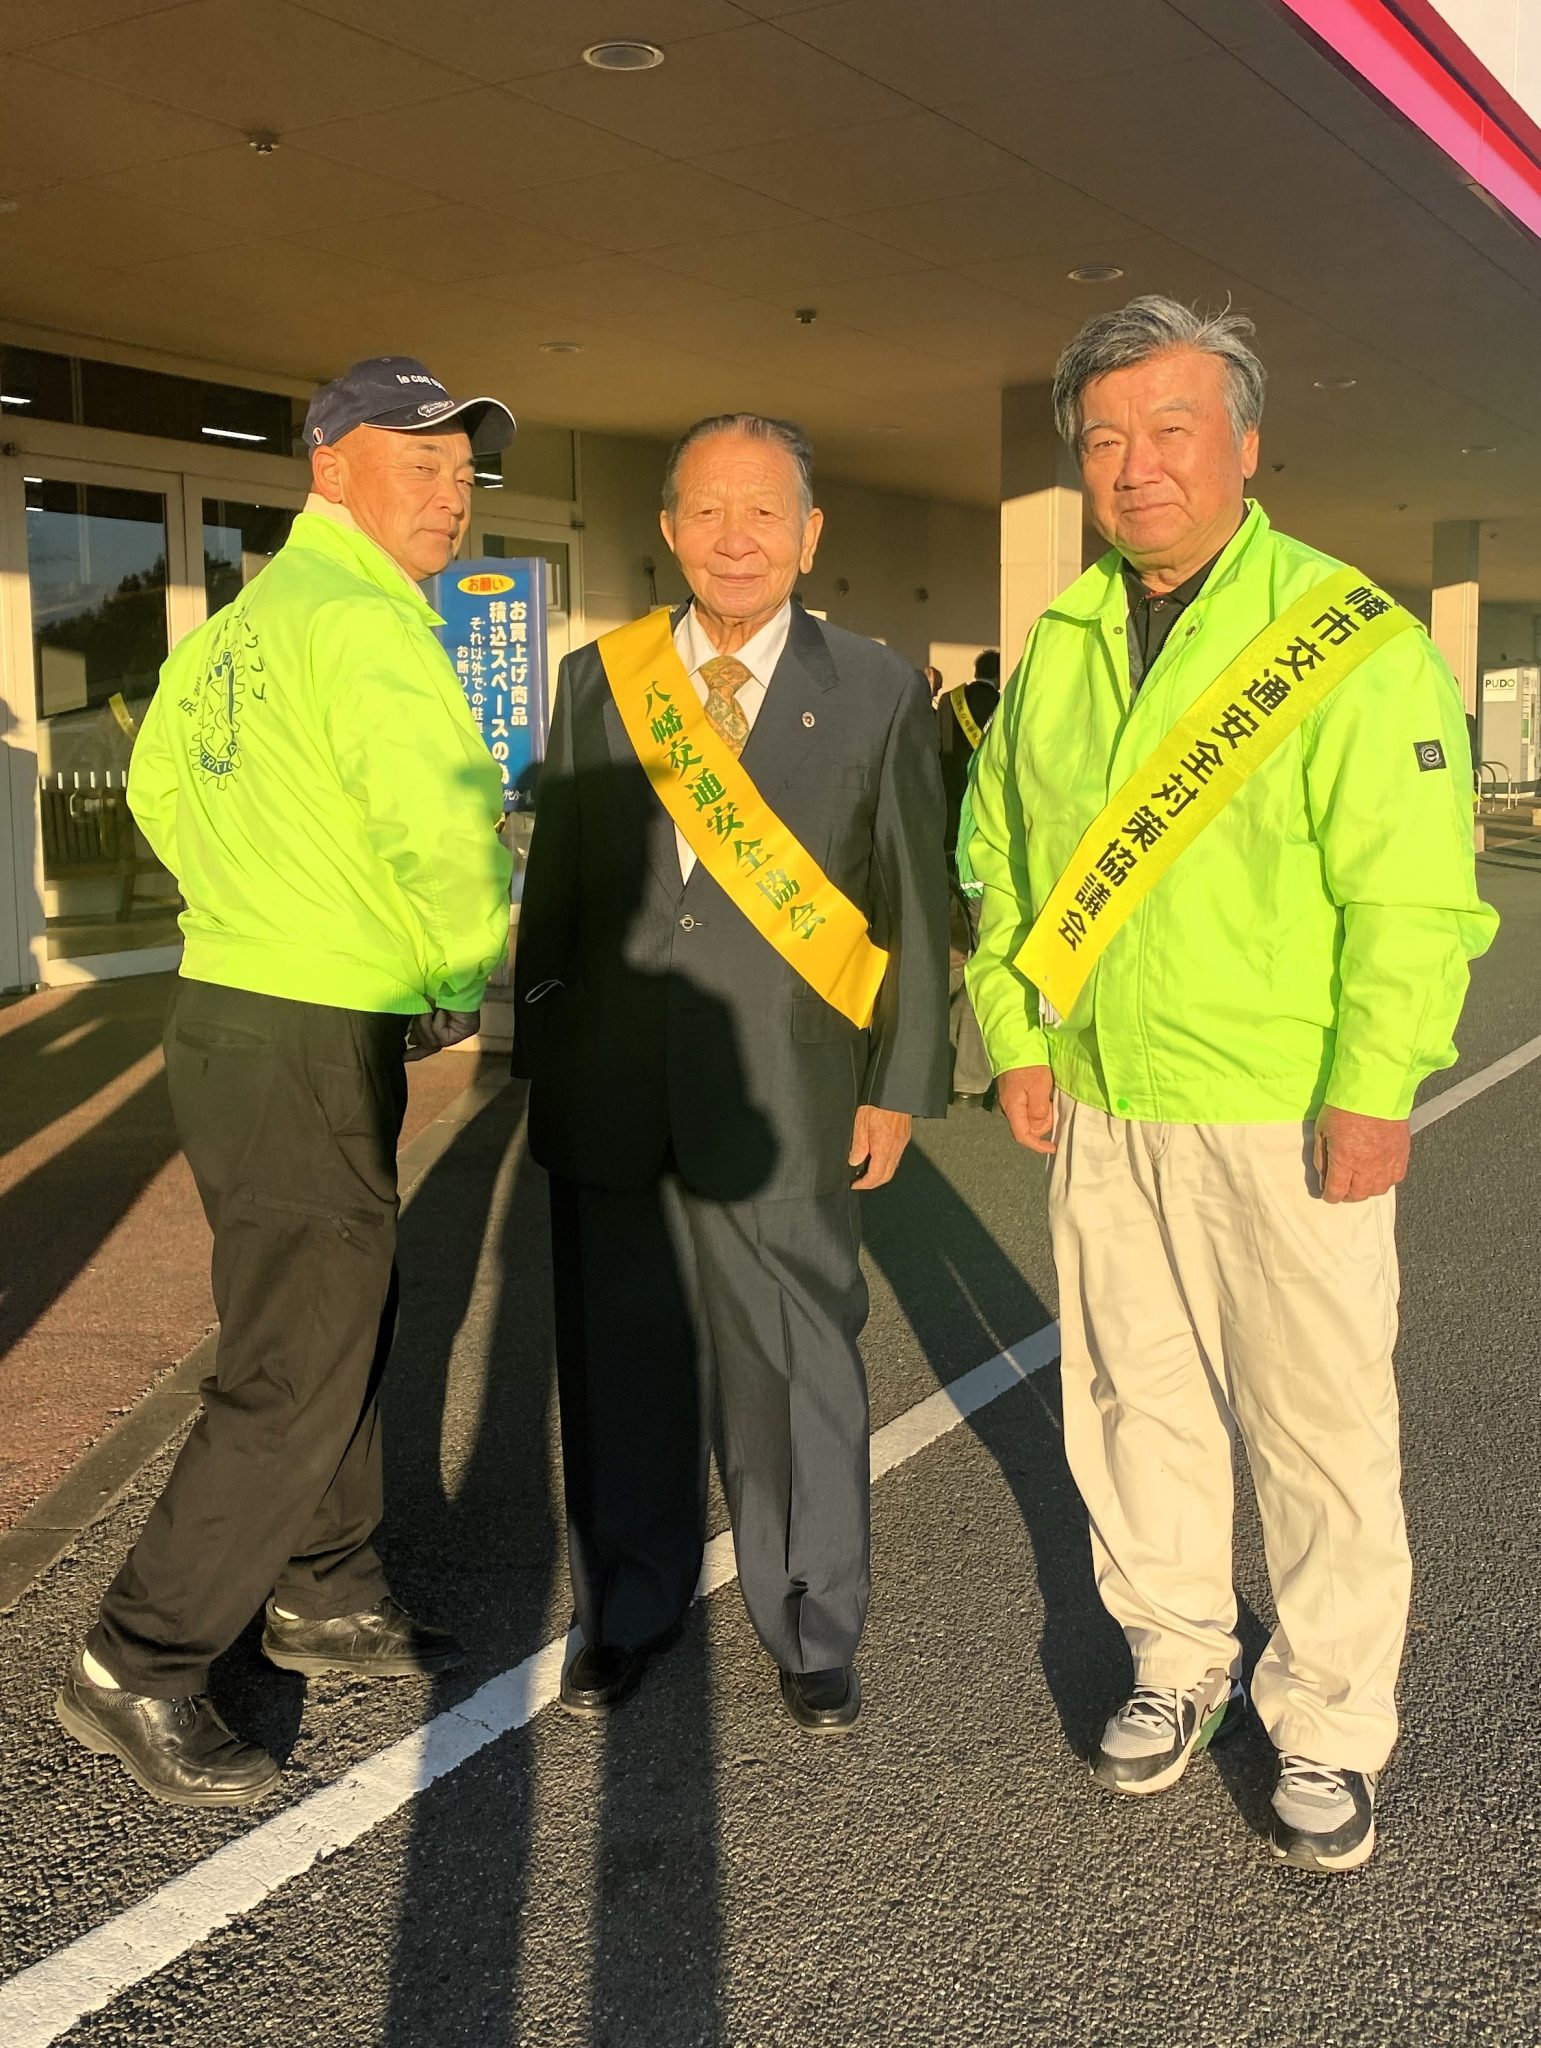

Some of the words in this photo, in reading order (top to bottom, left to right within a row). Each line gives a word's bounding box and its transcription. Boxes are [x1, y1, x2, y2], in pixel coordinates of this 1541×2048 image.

[468, 577, 504, 592] お願い
[457, 645, 469, 701] お断り
[510, 600, 528, 726] お買上げ商品
[1485, 679, 1516, 688] PUDO
[644, 680, 826, 940] 八幡交通安全協会
[1058, 585, 1394, 951] 幡市交通安全対策協議会
